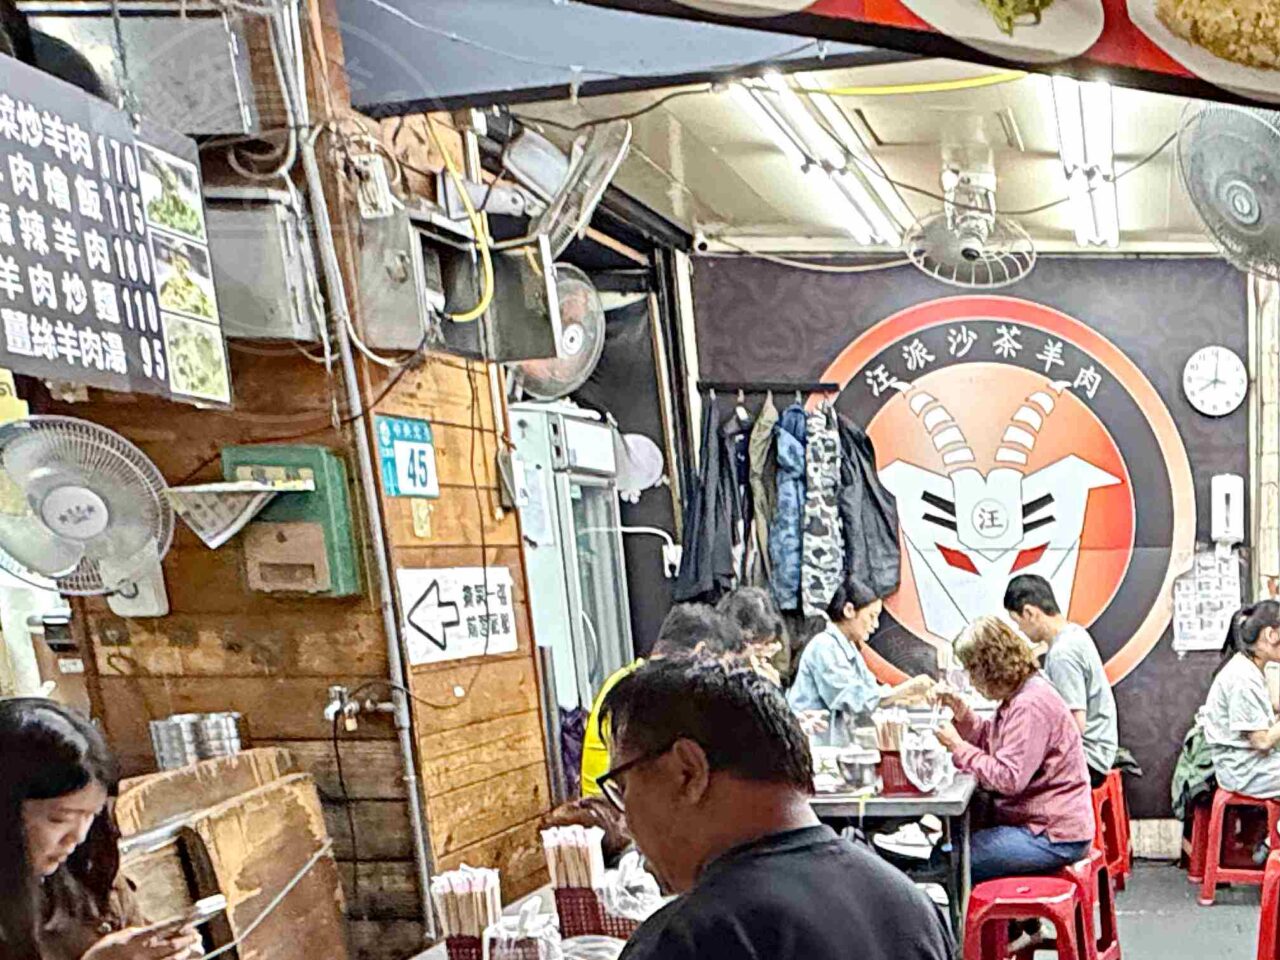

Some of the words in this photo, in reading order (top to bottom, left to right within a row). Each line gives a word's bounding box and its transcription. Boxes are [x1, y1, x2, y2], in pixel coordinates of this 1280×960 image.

[98, 136, 138, 189] 170
[0, 152, 104, 223] 肉燴飯
[104, 184, 145, 236] 115
[113, 238, 151, 286] 180
[122, 287, 159, 334] 110
[139, 335, 166, 381] 95
[866, 324, 1102, 398] 汪派沙茶羊肉
[407, 447, 428, 488] 45
[977, 507, 1004, 531] 汪
